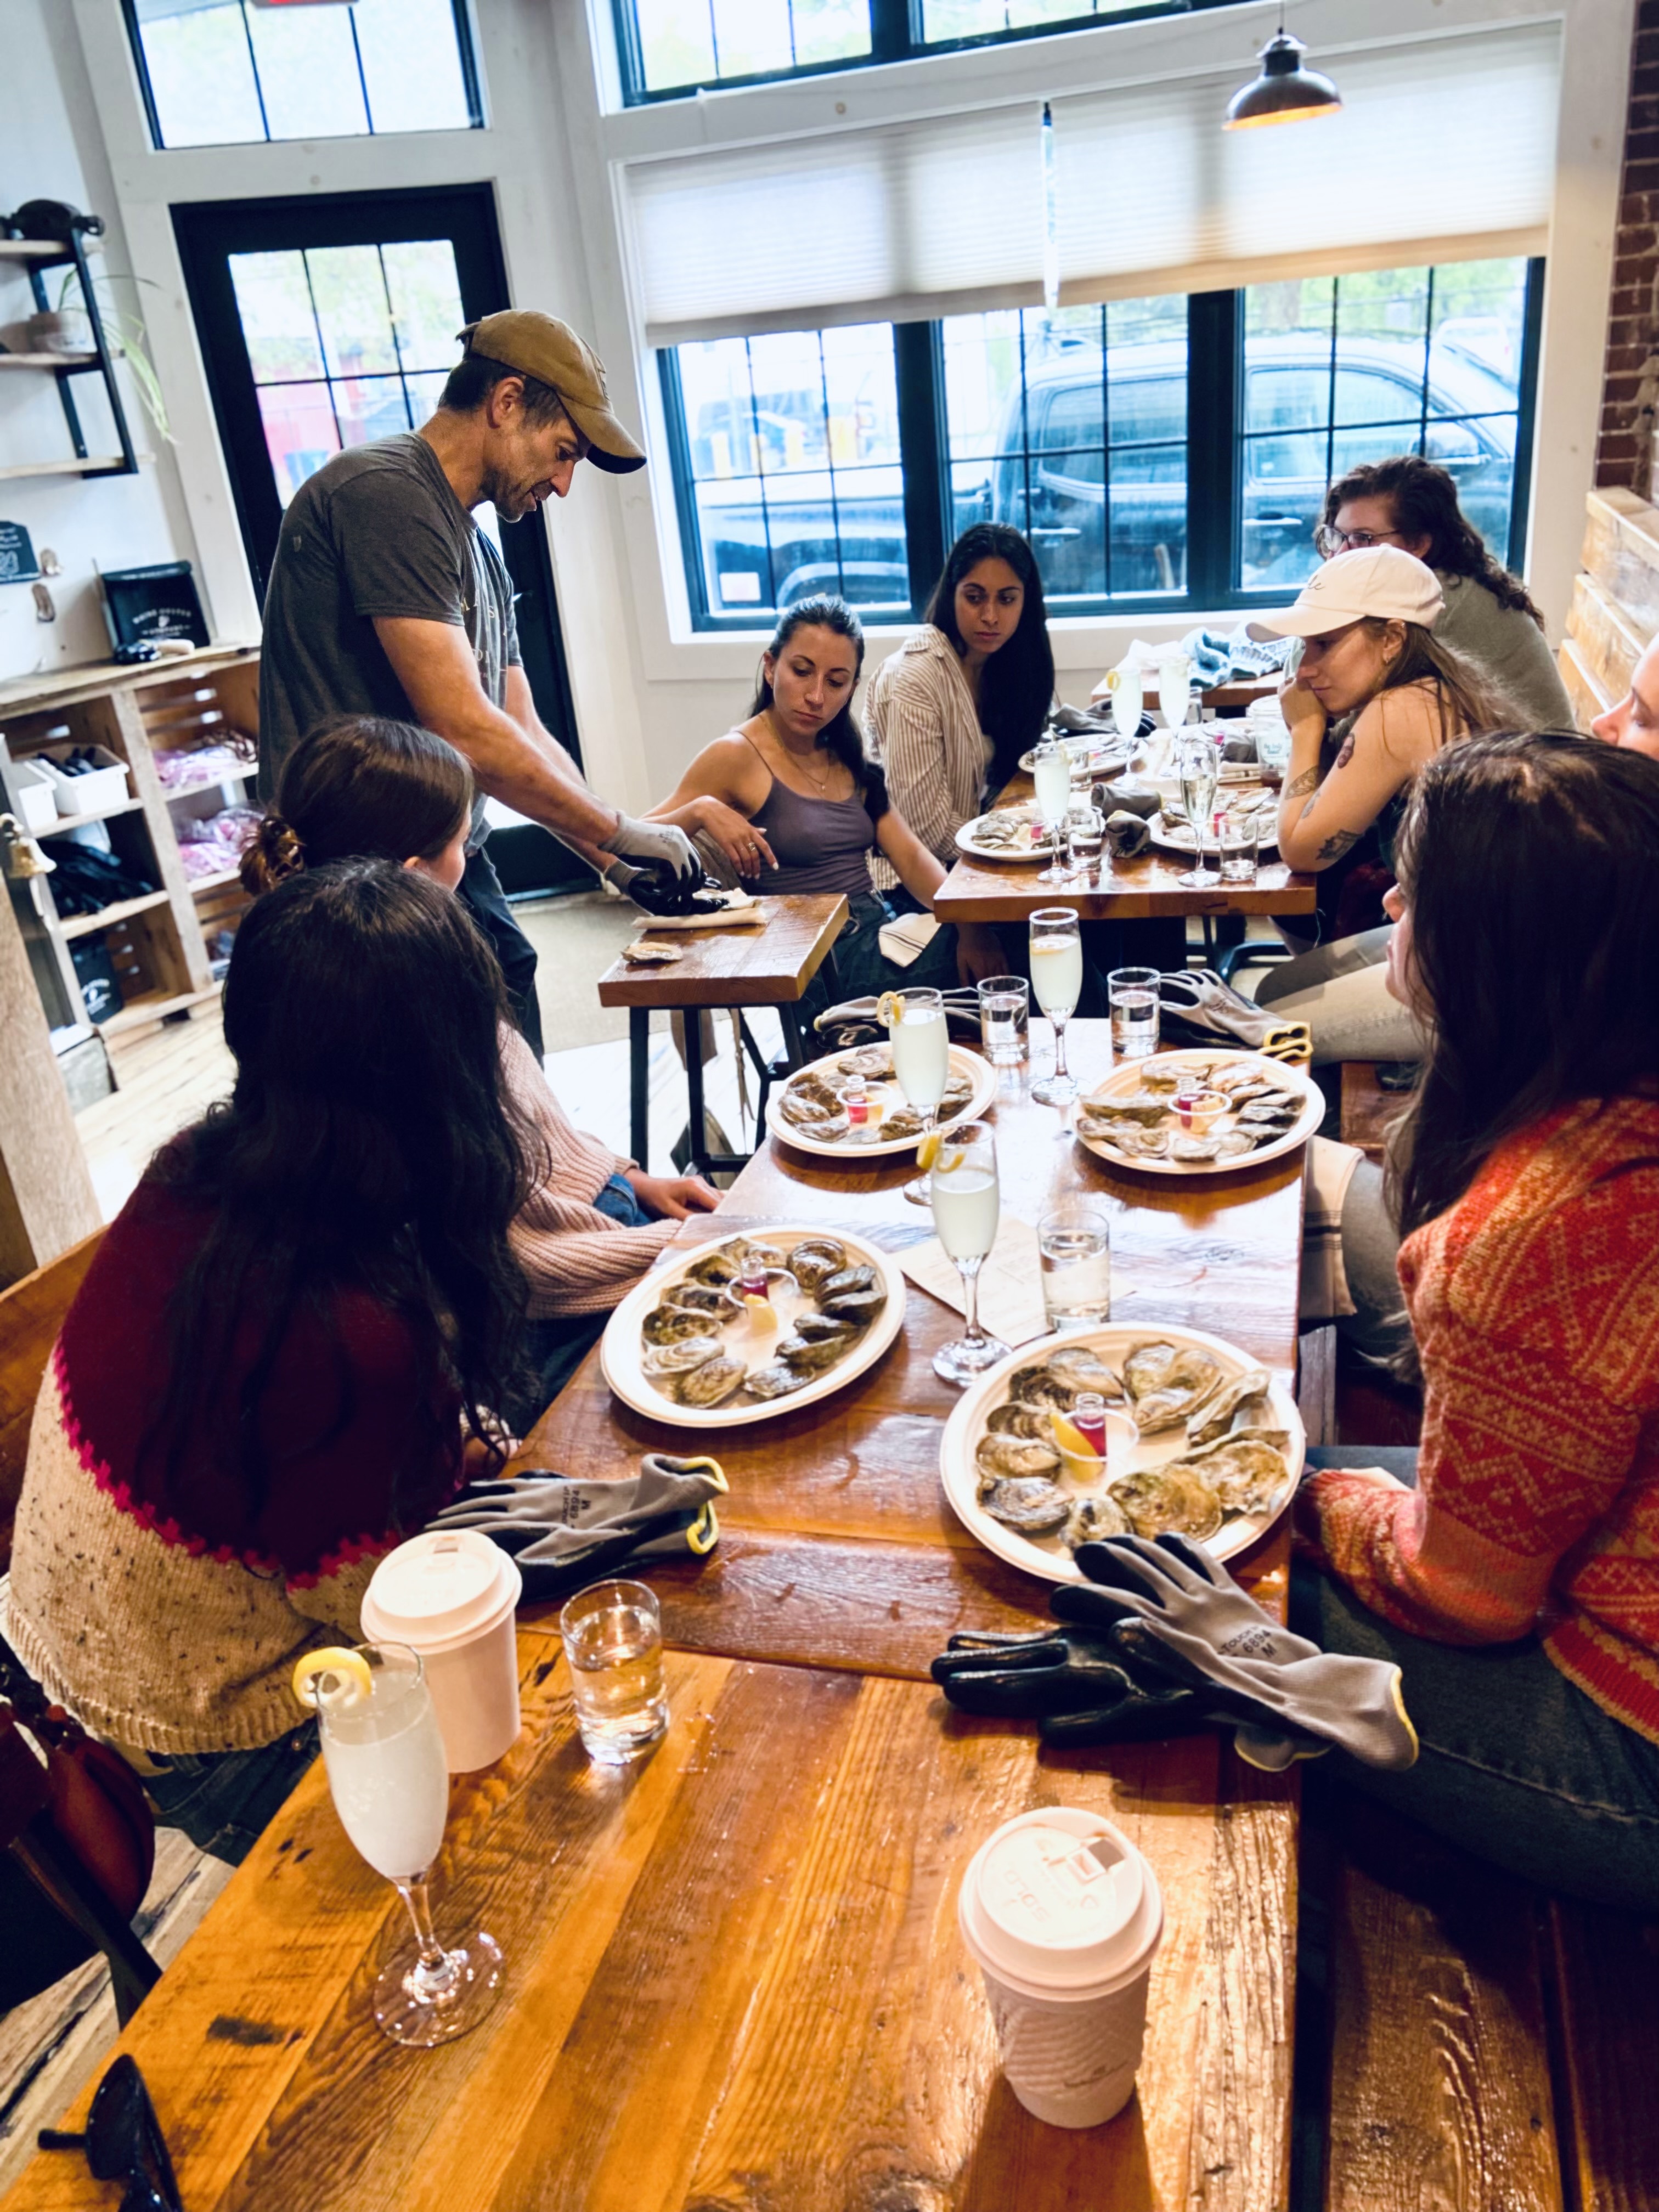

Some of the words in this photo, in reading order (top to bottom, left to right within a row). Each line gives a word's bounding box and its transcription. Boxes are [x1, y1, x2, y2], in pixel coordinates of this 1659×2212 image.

[582, 1499, 591, 1510] M
[1243, 1629, 1272, 1653] 6894
[1261, 1643, 1277, 1658] M
